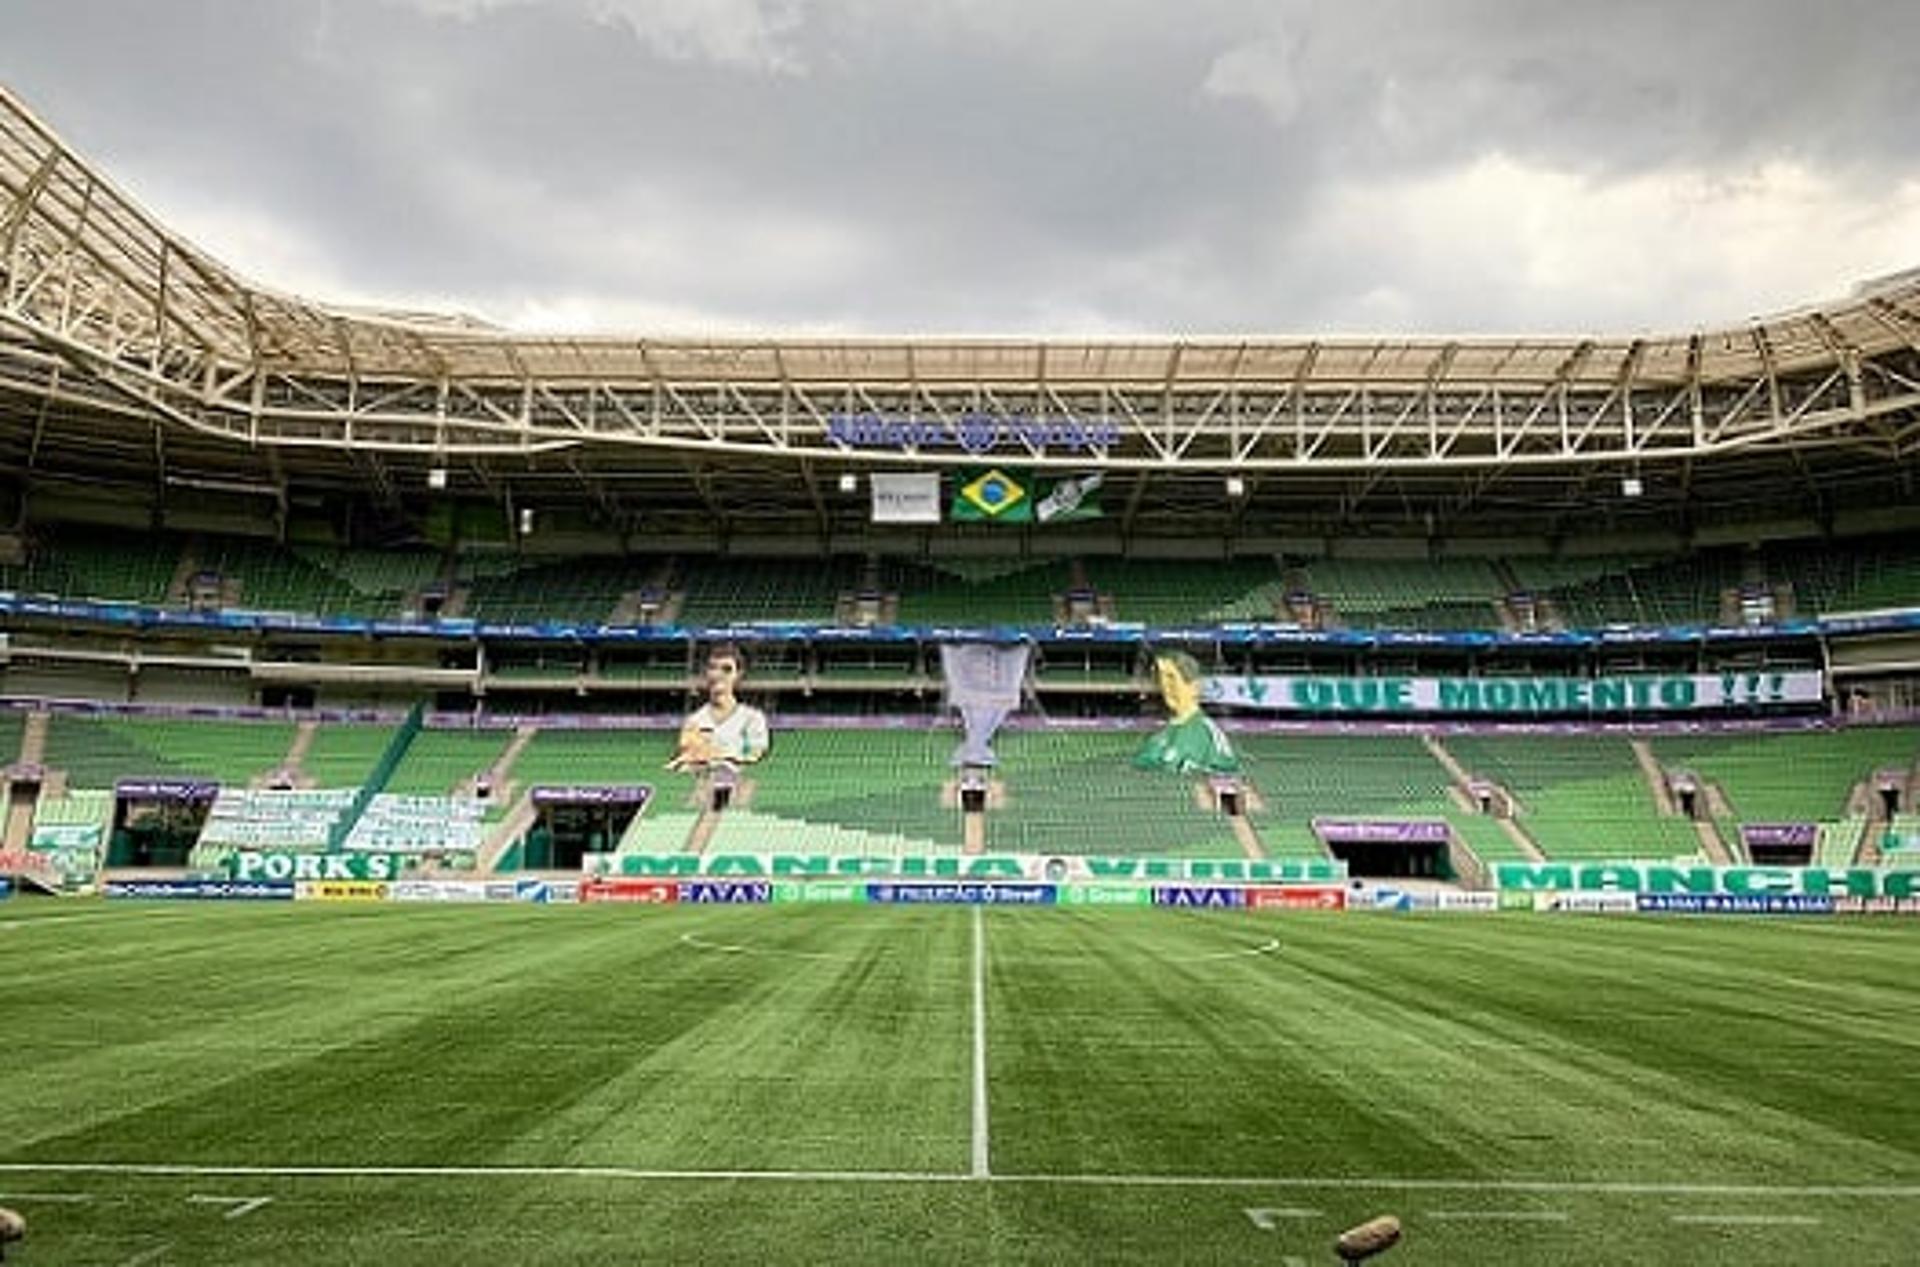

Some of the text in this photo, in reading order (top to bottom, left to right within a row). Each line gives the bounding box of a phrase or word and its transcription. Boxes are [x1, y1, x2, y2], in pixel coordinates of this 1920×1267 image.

[1291, 677, 1413, 710] QUE
[1435, 675, 1696, 712] MOMENTO
[620, 854, 1024, 876] MANCHA
